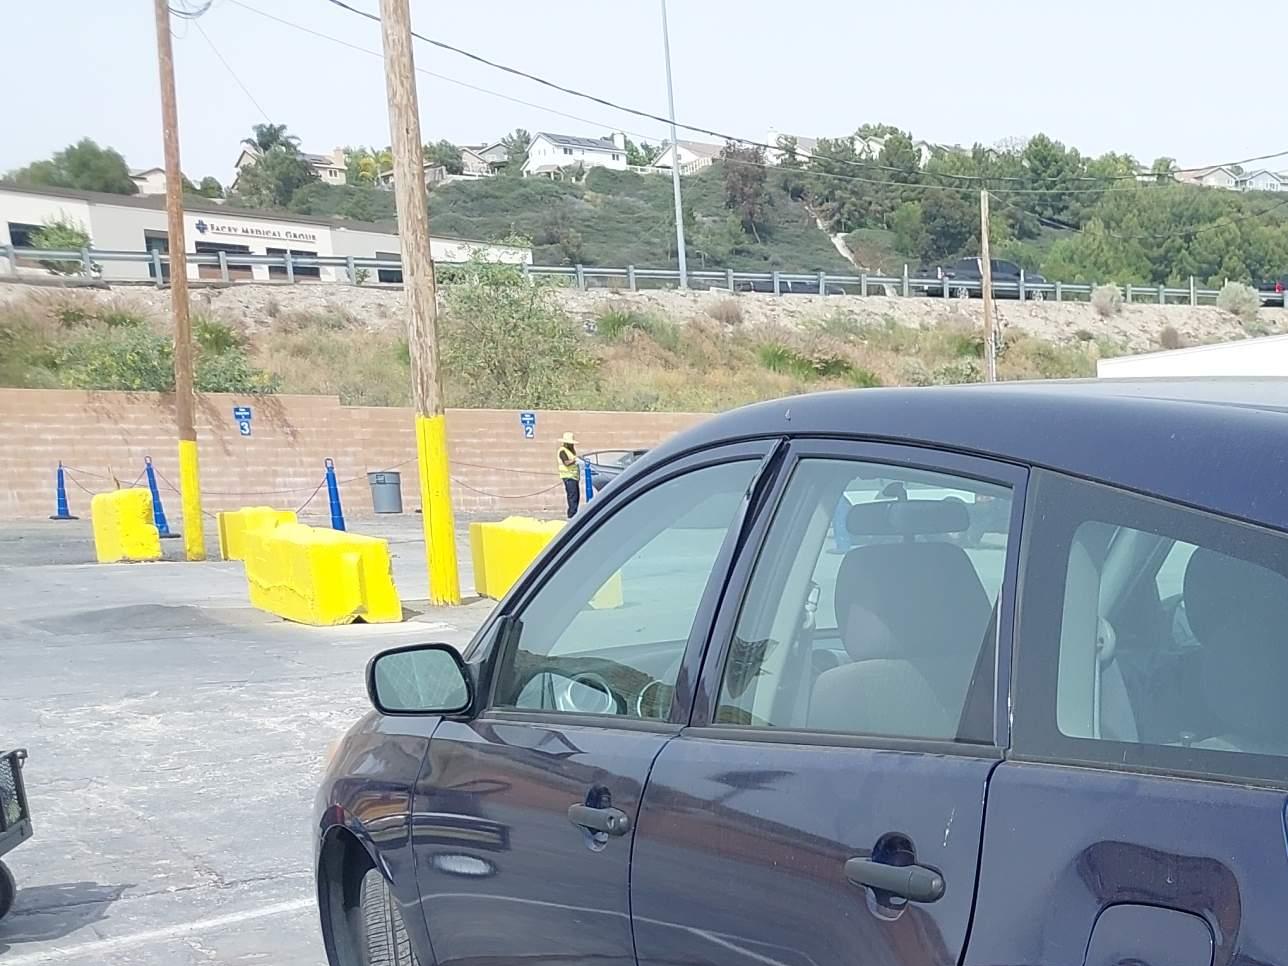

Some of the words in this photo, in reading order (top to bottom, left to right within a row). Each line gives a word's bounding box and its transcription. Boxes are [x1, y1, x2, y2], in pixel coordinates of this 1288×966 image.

[241, 227, 281, 238] MEDICAL
[285, 231, 317, 241] GROUP
[240, 421, 250, 434] 3
[525, 426, 534, 438] 2
